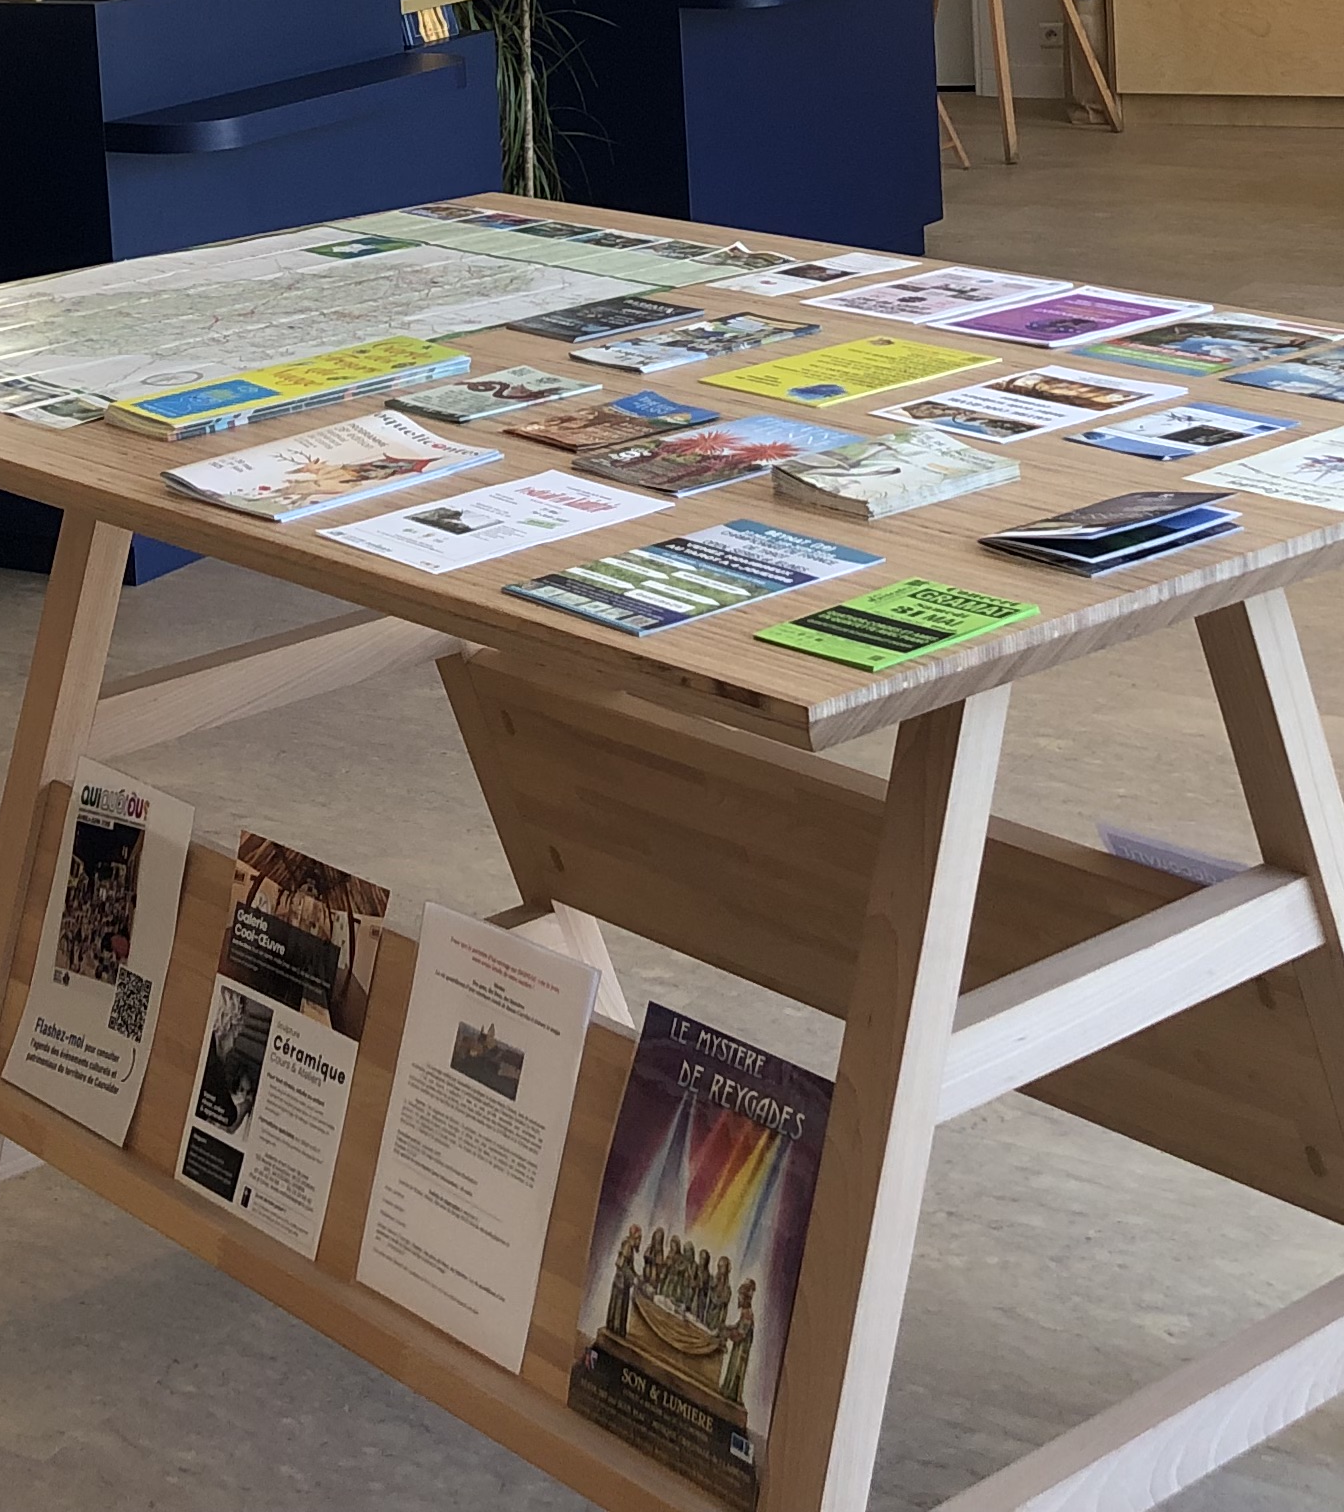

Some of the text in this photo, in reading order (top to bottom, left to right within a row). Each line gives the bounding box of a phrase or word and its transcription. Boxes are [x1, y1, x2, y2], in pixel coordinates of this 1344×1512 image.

[886, 604, 966, 627] 31 MAI
[910, 589, 1016, 618] GRAMAT
[237, 909, 268, 931] Galerie
[234, 923, 285, 955] Cool-Œuvre
[35, 1017, 86, 1049] Flashez-moi
[670, 1017, 767, 1079] LE MYSTERE
[270, 1051, 290, 1070] Cours
[273, 1035, 346, 1085] Céramique
[677, 1059, 805, 1140] DE REYGADES
[621, 1367, 714, 1433] SON & LUMIERE
